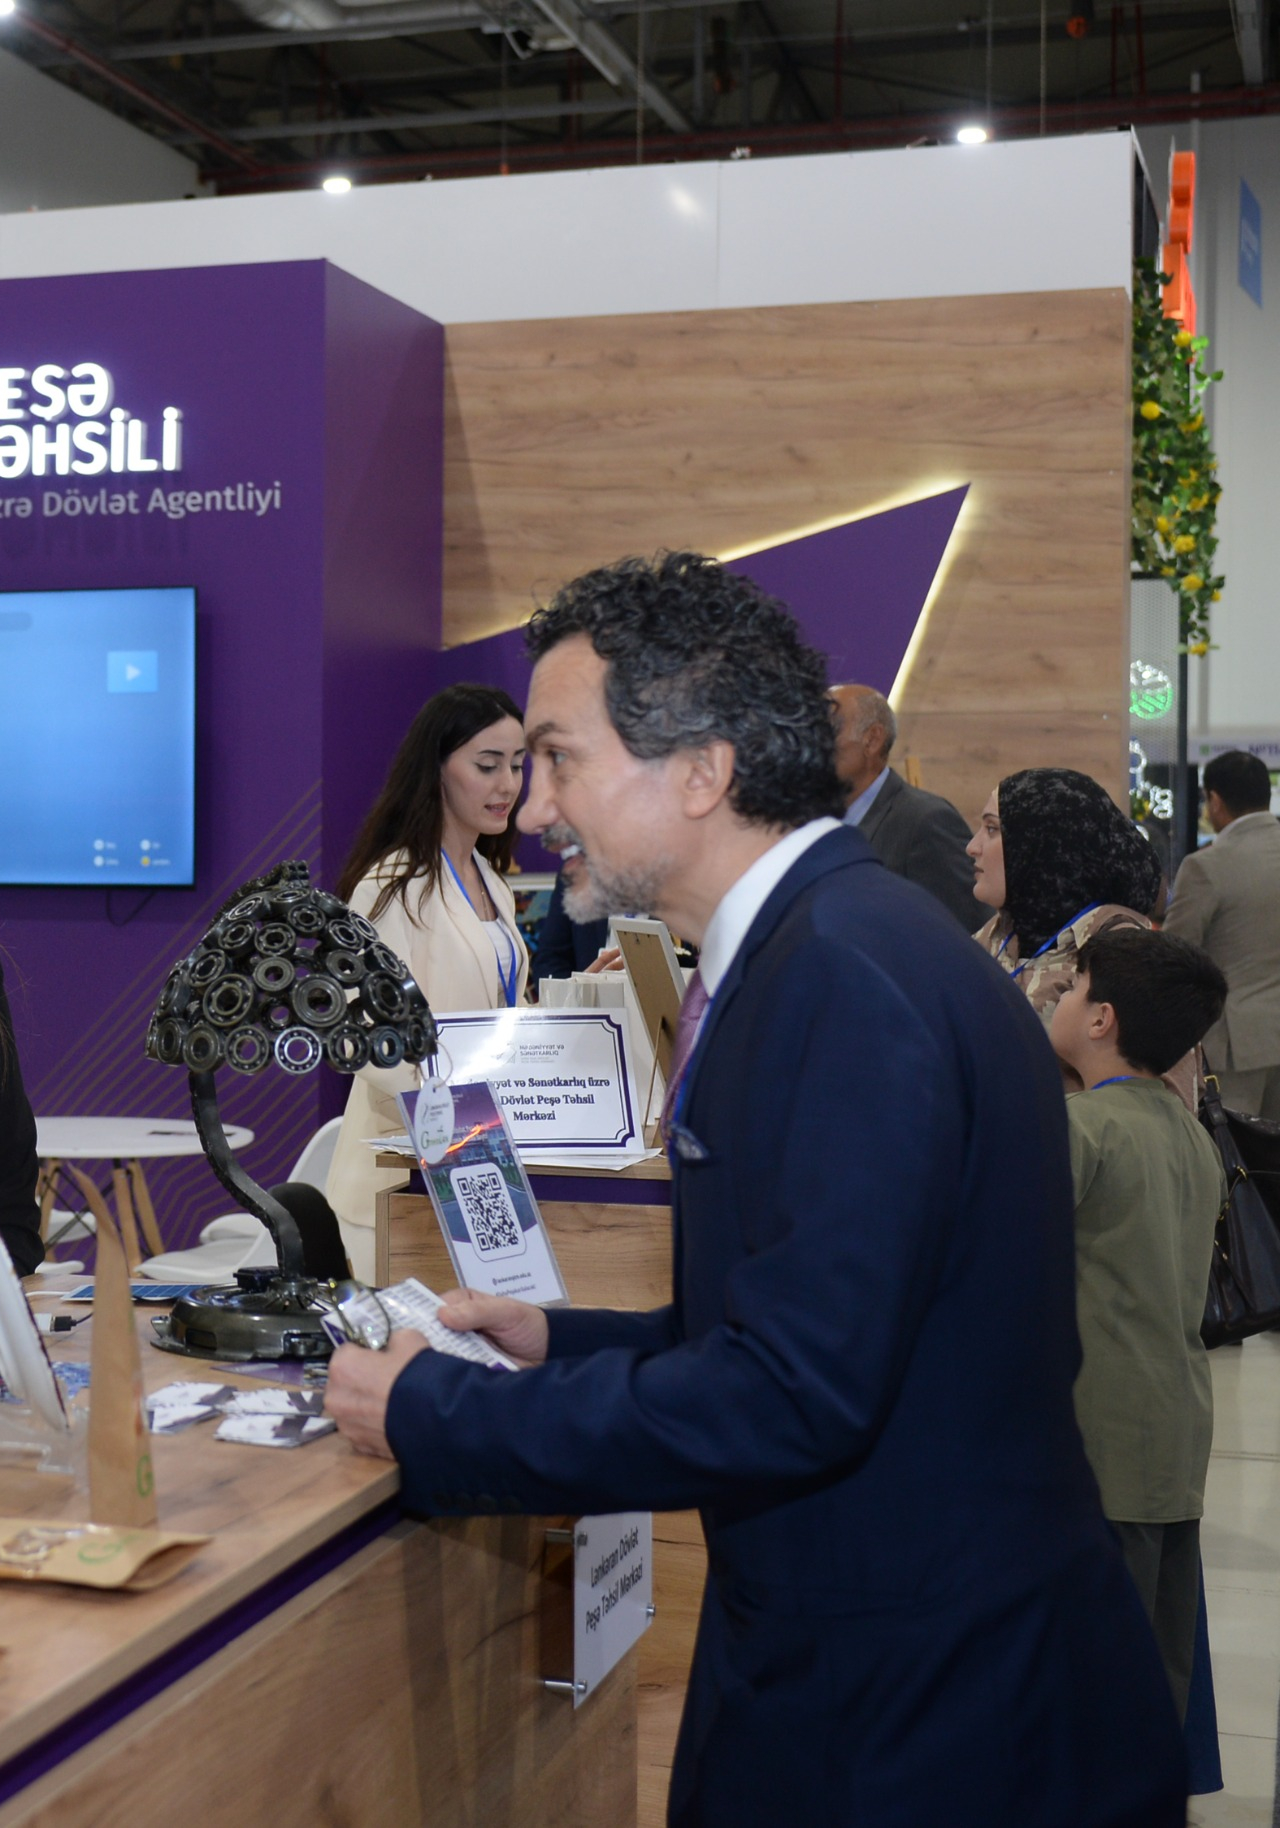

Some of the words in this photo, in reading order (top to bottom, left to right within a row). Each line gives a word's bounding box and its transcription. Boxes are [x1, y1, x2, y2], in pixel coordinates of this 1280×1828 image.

[42, 488, 139, 517] Dövlət
[147, 482, 282, 520] Agentliyi
[514, 1079, 526, 1088] və
[528, 1076, 586, 1088] Sənətkarlıq
[588, 1076, 610, 1087] üzrə
[500, 1094, 535, 1106] Dövlət
[537, 1094, 561, 1106] Peşə
[562, 1094, 595, 1104] Təhsil
[513, 1110, 556, 1121] Mərkəzi
